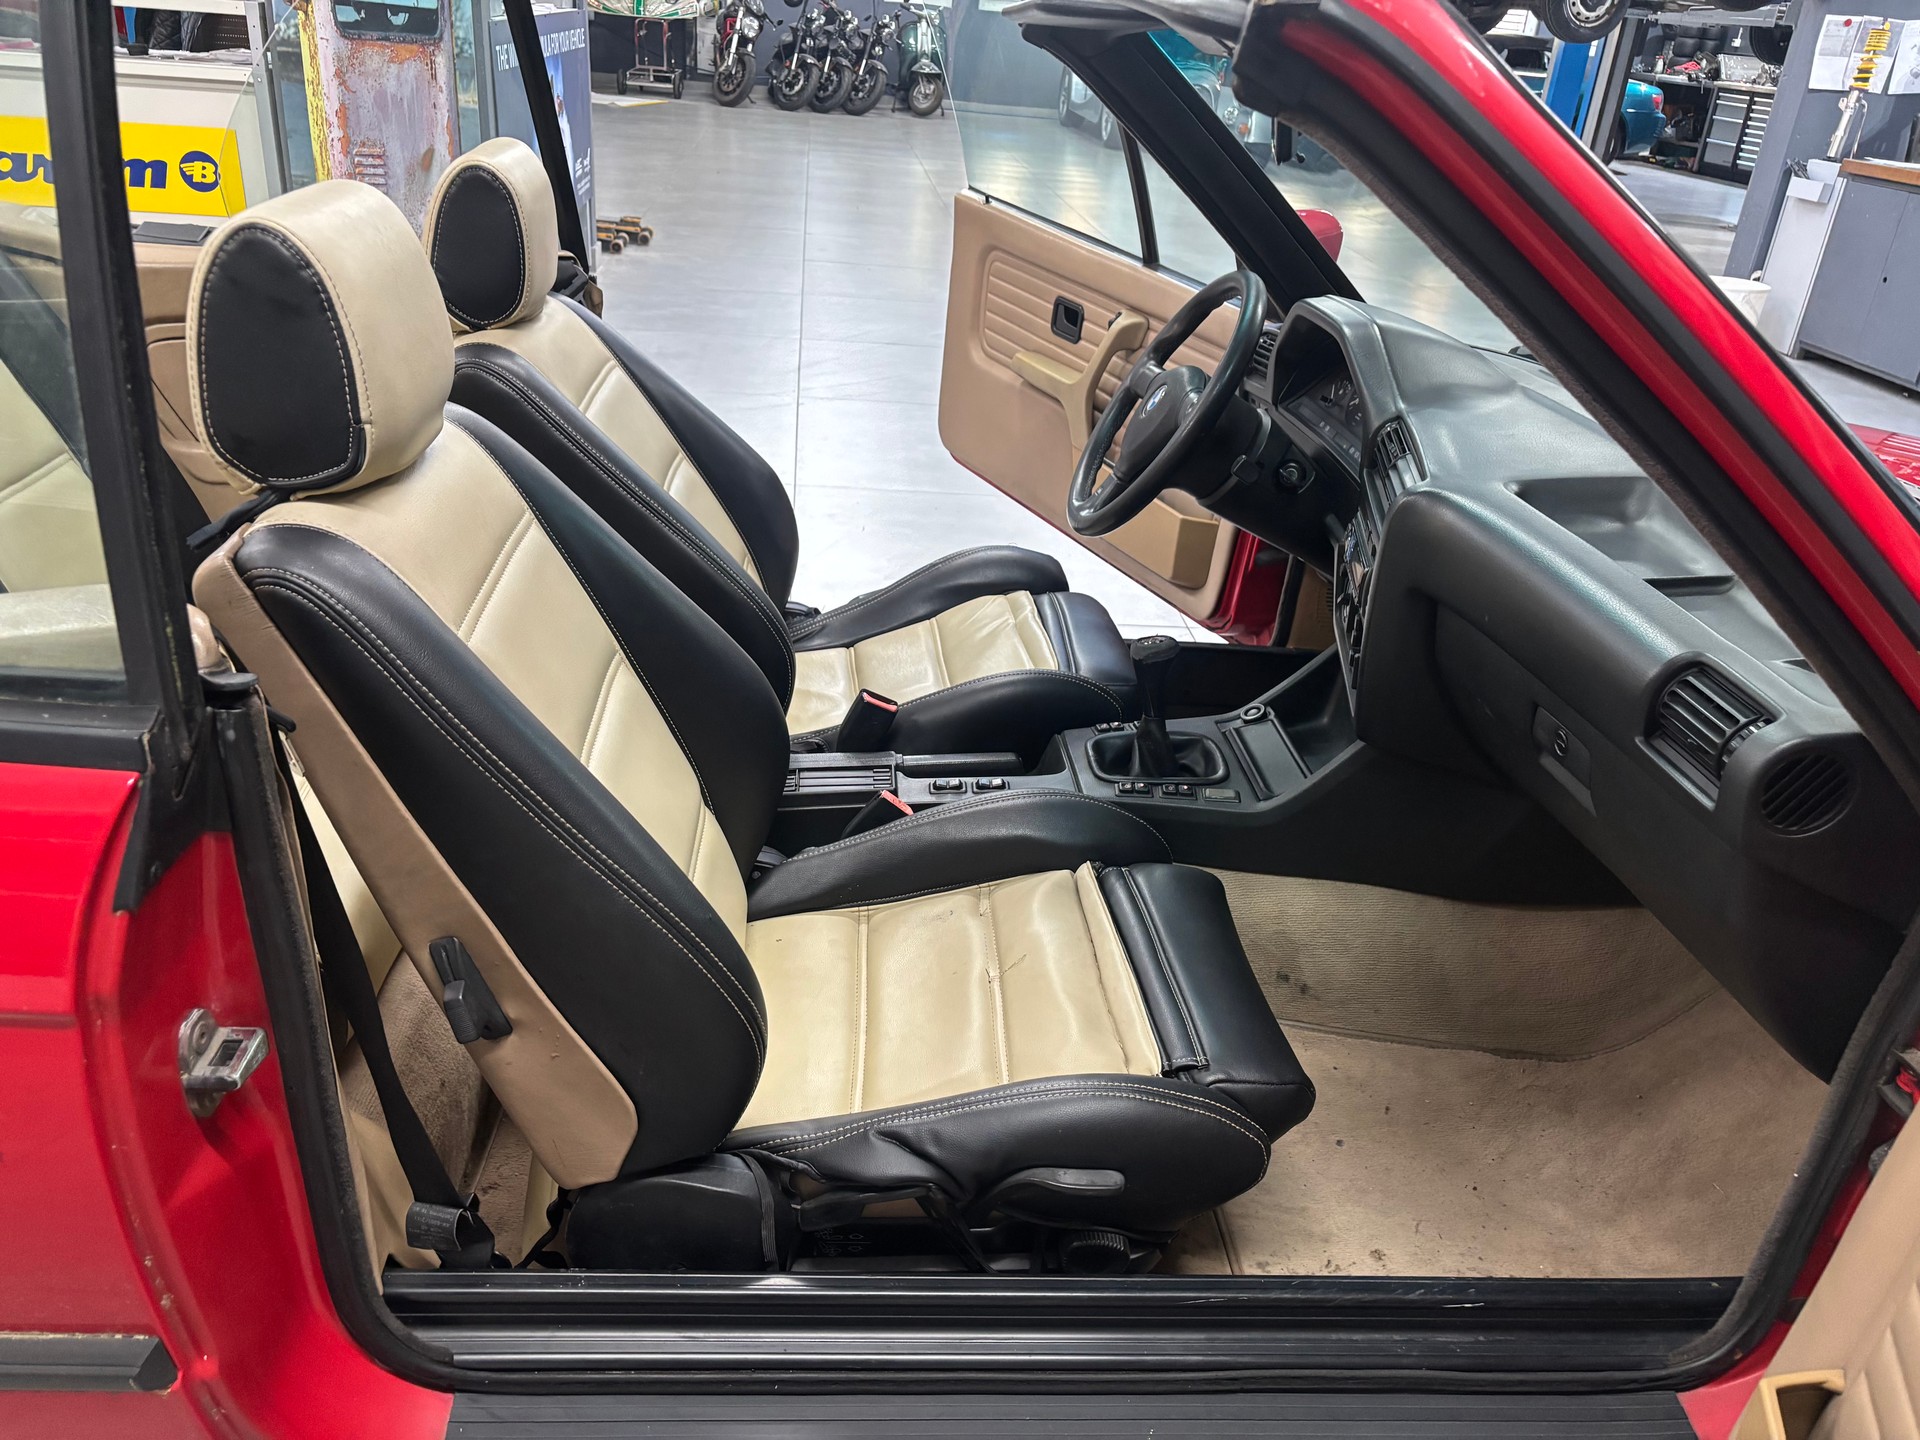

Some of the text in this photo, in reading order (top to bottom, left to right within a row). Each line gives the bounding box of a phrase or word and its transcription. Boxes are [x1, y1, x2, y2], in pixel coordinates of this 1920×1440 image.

[496, 44, 508, 71] THE
[551, 32, 559, 55] FOR
[559, 31, 569, 52] YOUR
[569, 28, 585, 49] VEHICLE
